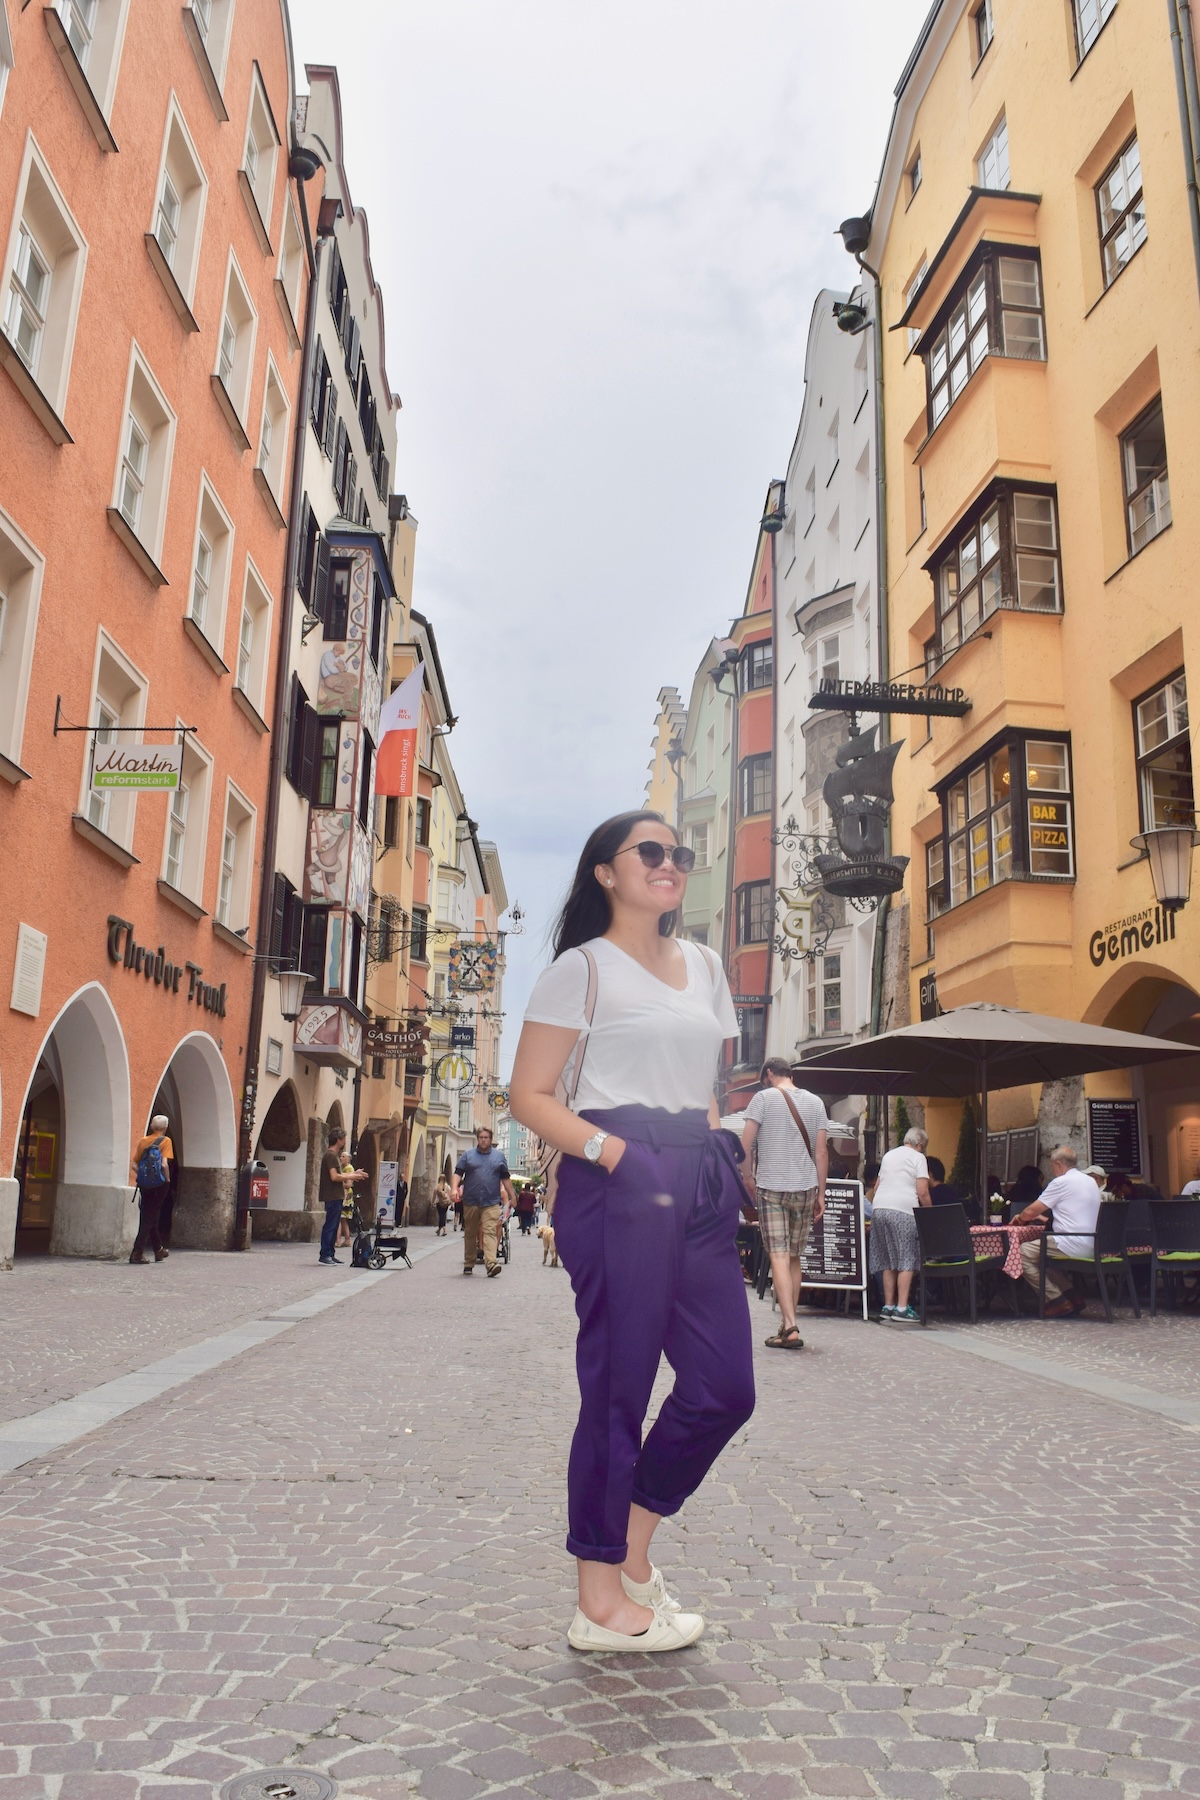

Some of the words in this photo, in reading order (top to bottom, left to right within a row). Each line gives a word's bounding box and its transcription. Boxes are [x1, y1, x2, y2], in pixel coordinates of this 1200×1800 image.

[819, 678, 917, 701] UNTERBERGER
[402, 739, 411, 757] singt
[95, 750, 178, 772] Martin
[101, 775, 171, 785] reformstark
[399, 757, 408, 793] Innsbruck
[1032, 805, 1057, 820] BAR
[1032, 830, 1067, 845] PIZZA
[1104, 908, 1153, 936] RESTAURANT
[1089, 906, 1176, 967] Gemelli
[304, 1009, 328, 1035] 1925
[367, 1029, 422, 1043] GASTHOF
[454, 1032, 471, 1040] arko
